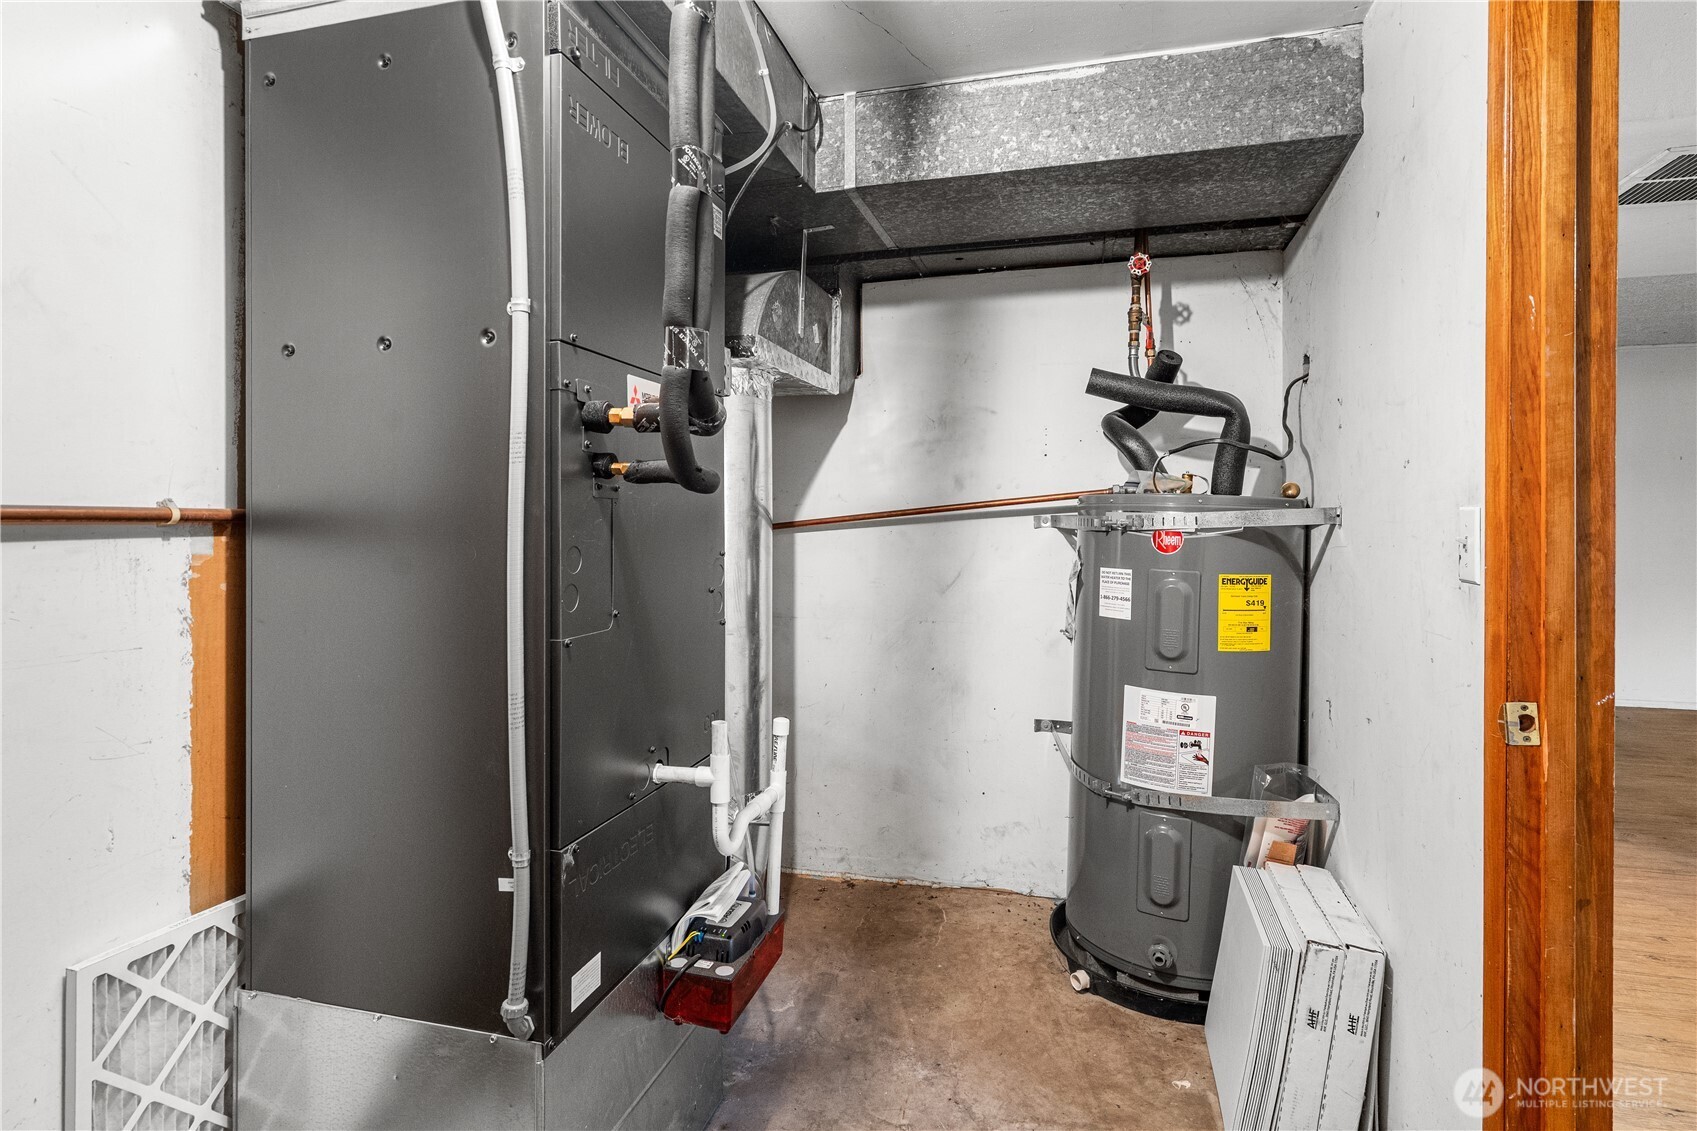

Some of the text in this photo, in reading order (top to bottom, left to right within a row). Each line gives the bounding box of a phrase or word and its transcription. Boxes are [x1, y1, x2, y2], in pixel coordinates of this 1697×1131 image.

[568, 19, 620, 88] FILTER
[568, 94, 630, 165] BLOWER
[1155, 530, 1182, 550] Rheem
[1222, 578, 1268, 586] ENERGYGUIDE
[1100, 594, 1131, 602] 1-866-279-4566
[1307, 1008, 1318, 1029] AHF
[1347, 1012, 1358, 1035] AHF
